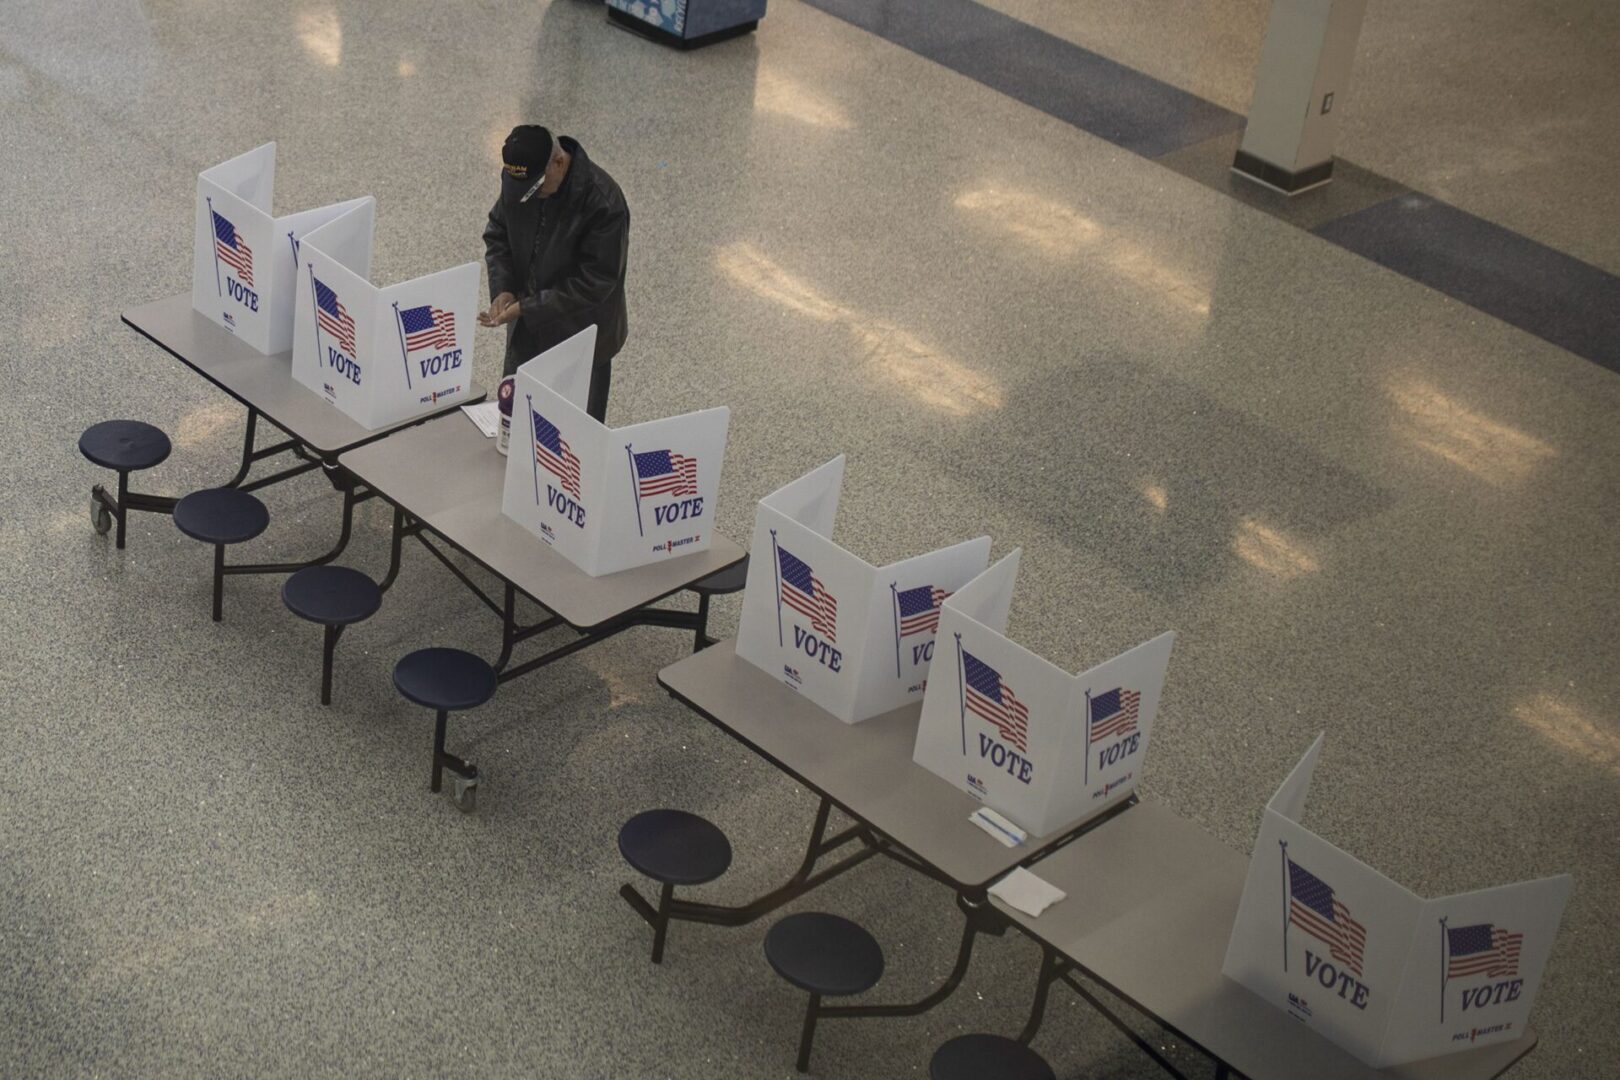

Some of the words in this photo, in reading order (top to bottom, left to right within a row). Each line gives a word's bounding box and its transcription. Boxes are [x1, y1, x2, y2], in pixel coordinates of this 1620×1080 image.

[227, 276, 259, 312] VOTE
[328, 346, 361, 385] VOTE
[420, 349, 462, 378] VOTE
[420, 394, 432, 403] POLL
[436, 387, 455, 398] MASTER
[547, 484, 586, 529] VOTE
[654, 497, 704, 526] VOTE
[652, 543, 666, 552] POLL
[672, 536, 693, 547] MASTER
[794, 624, 842, 673] VOTE
[912, 640, 935, 665] VO
[908, 683, 922, 693] POLL
[979, 733, 1033, 785] VOTE
[1099, 732, 1141, 771] VOTE
[1305, 950, 1370, 1010] VOTE
[1462, 979, 1524, 1011] VOTE
[1452, 1031, 1469, 1042] POLL
[1476, 1024, 1504, 1036] MASTER
